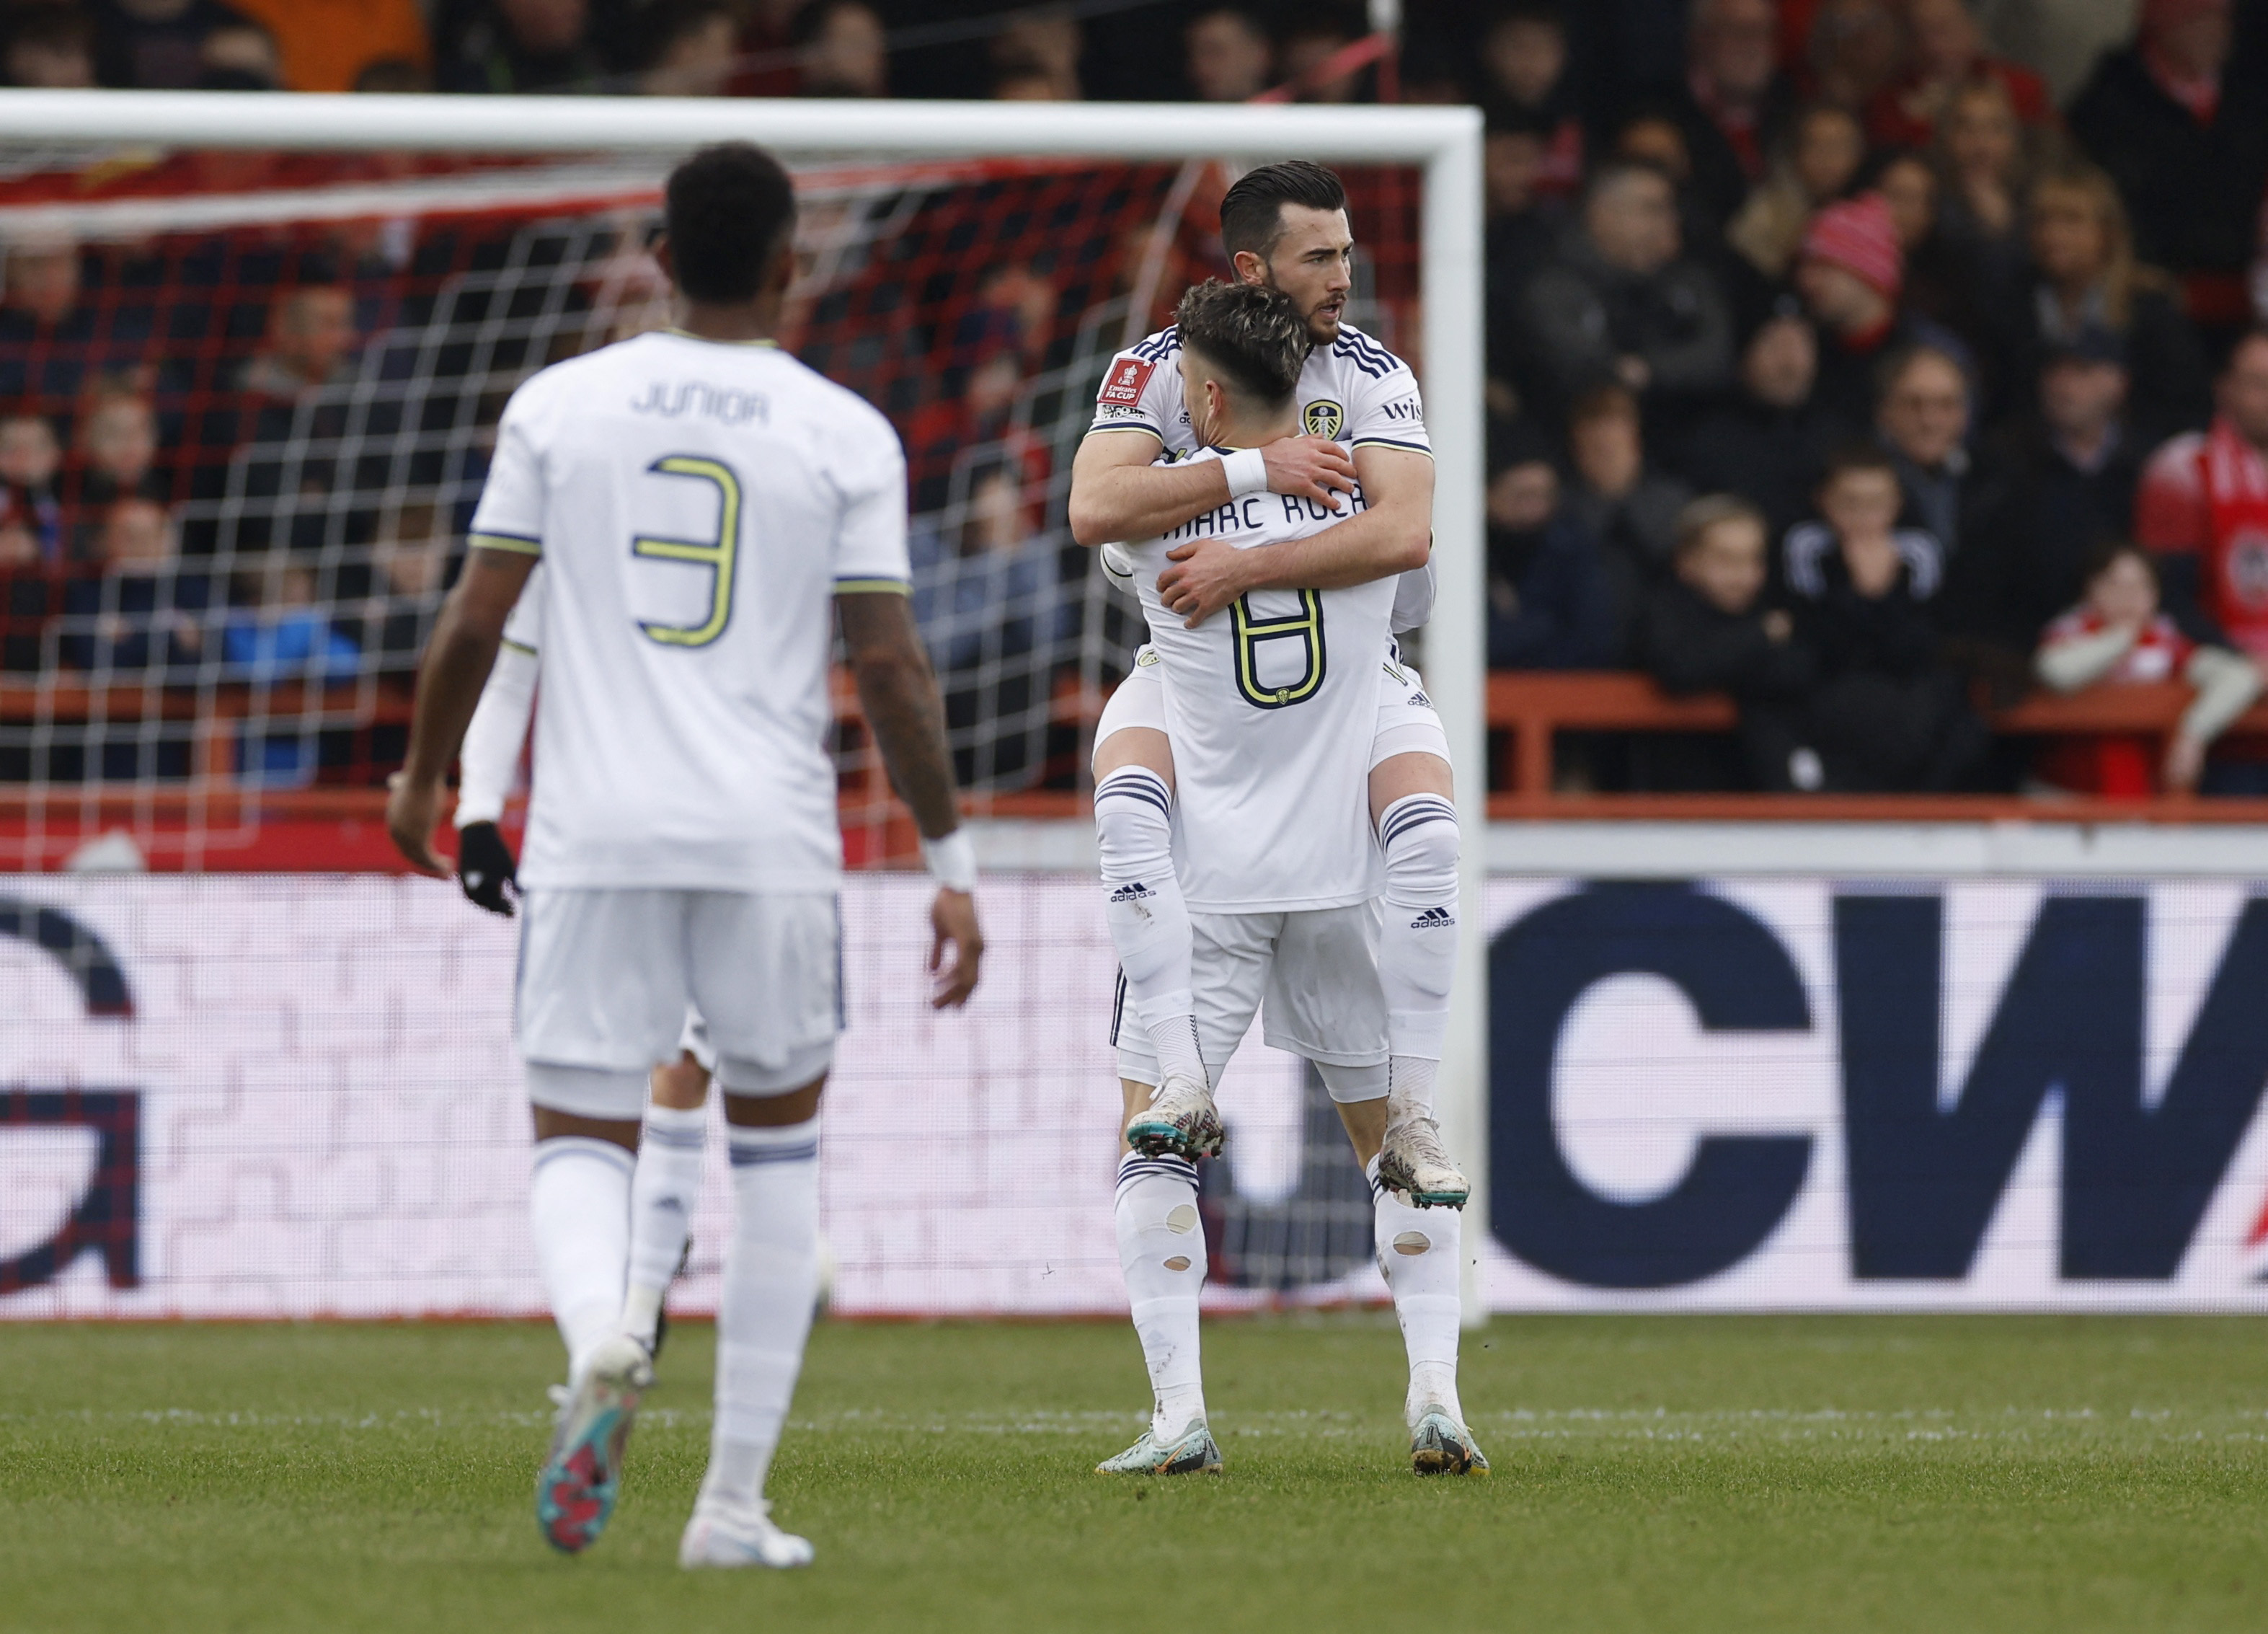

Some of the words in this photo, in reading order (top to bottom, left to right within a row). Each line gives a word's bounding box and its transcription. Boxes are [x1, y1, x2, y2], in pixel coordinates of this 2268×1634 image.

[632, 381, 769, 426] JUNIOR
[1109, 385, 1137, 394] Emirates
[632, 454, 743, 648] 3
[1228, 588, 1326, 710] 8
[1110, 890, 1156, 902] adidas
[1411, 918, 1455, 928] adidas
